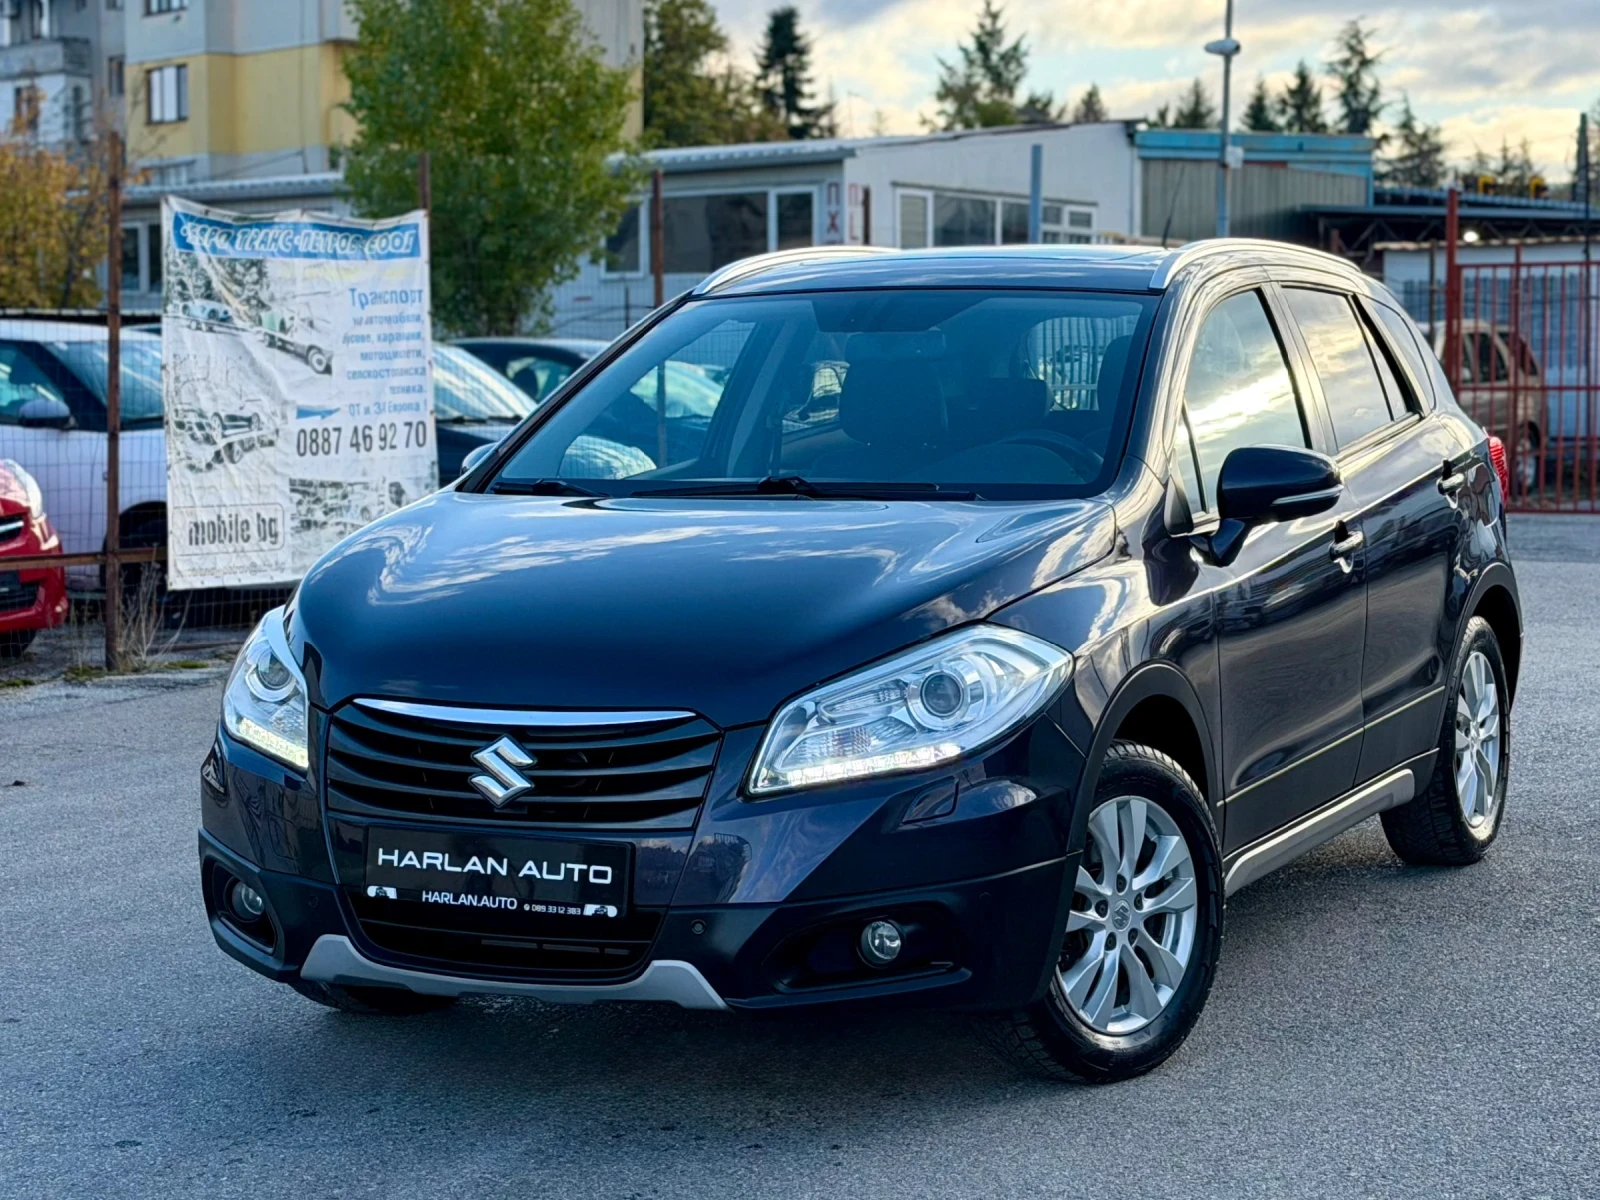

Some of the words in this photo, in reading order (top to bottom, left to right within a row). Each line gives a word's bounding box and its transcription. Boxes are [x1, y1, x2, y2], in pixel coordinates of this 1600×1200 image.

[348, 287, 424, 310] Транспорт
[296, 427, 342, 457] 0887
[350, 425, 373, 453] 46
[378, 422, 397, 450] 92
[403, 420, 427, 448] 70
[377, 847, 508, 876] HARLAN
[518, 860, 612, 885] AUTO
[421, 890, 518, 910] HARLAN.AUTO
